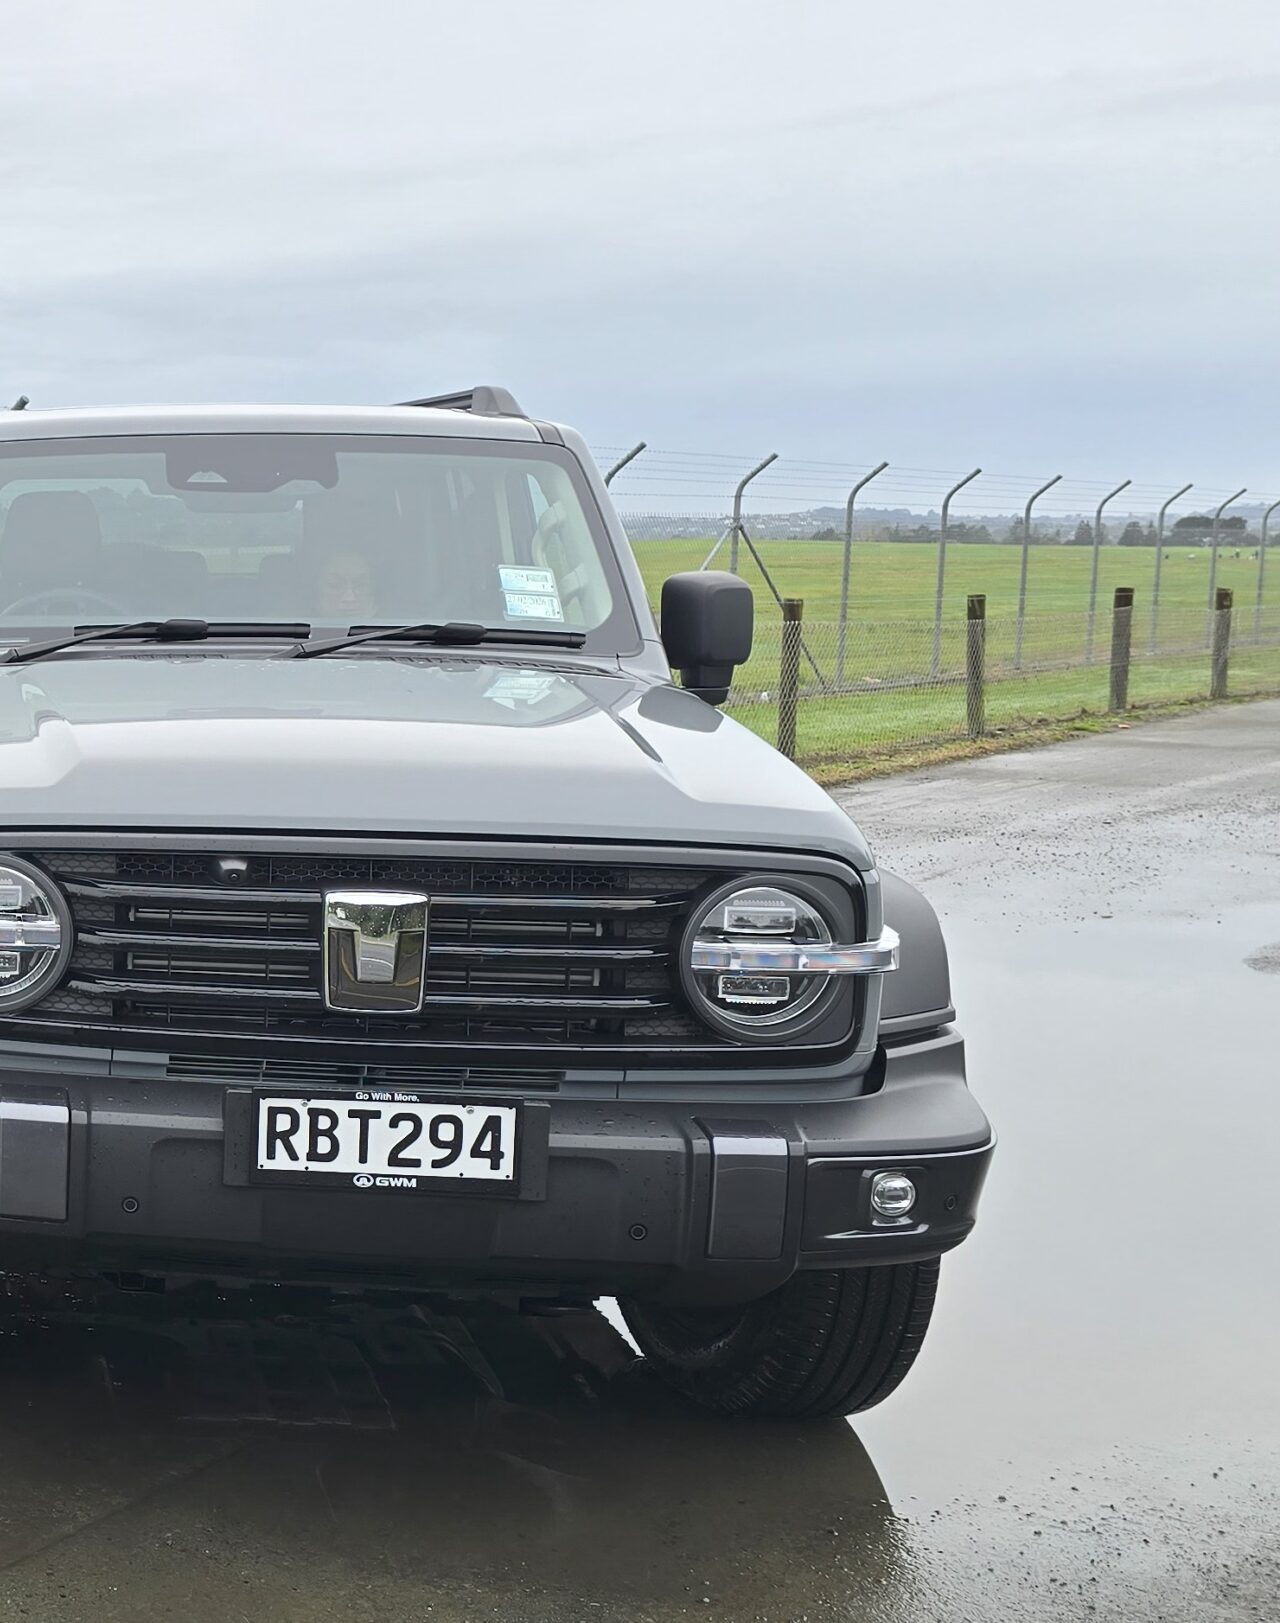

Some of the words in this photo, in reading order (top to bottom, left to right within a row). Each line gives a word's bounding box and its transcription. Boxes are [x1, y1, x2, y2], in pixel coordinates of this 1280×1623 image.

[355, 1092, 369, 1100] Go
[371, 1092, 392, 1100] With
[394, 1093, 420, 1102] More.
[265, 1105, 506, 1171] RBT294
[375, 1177, 417, 1188] GWM
